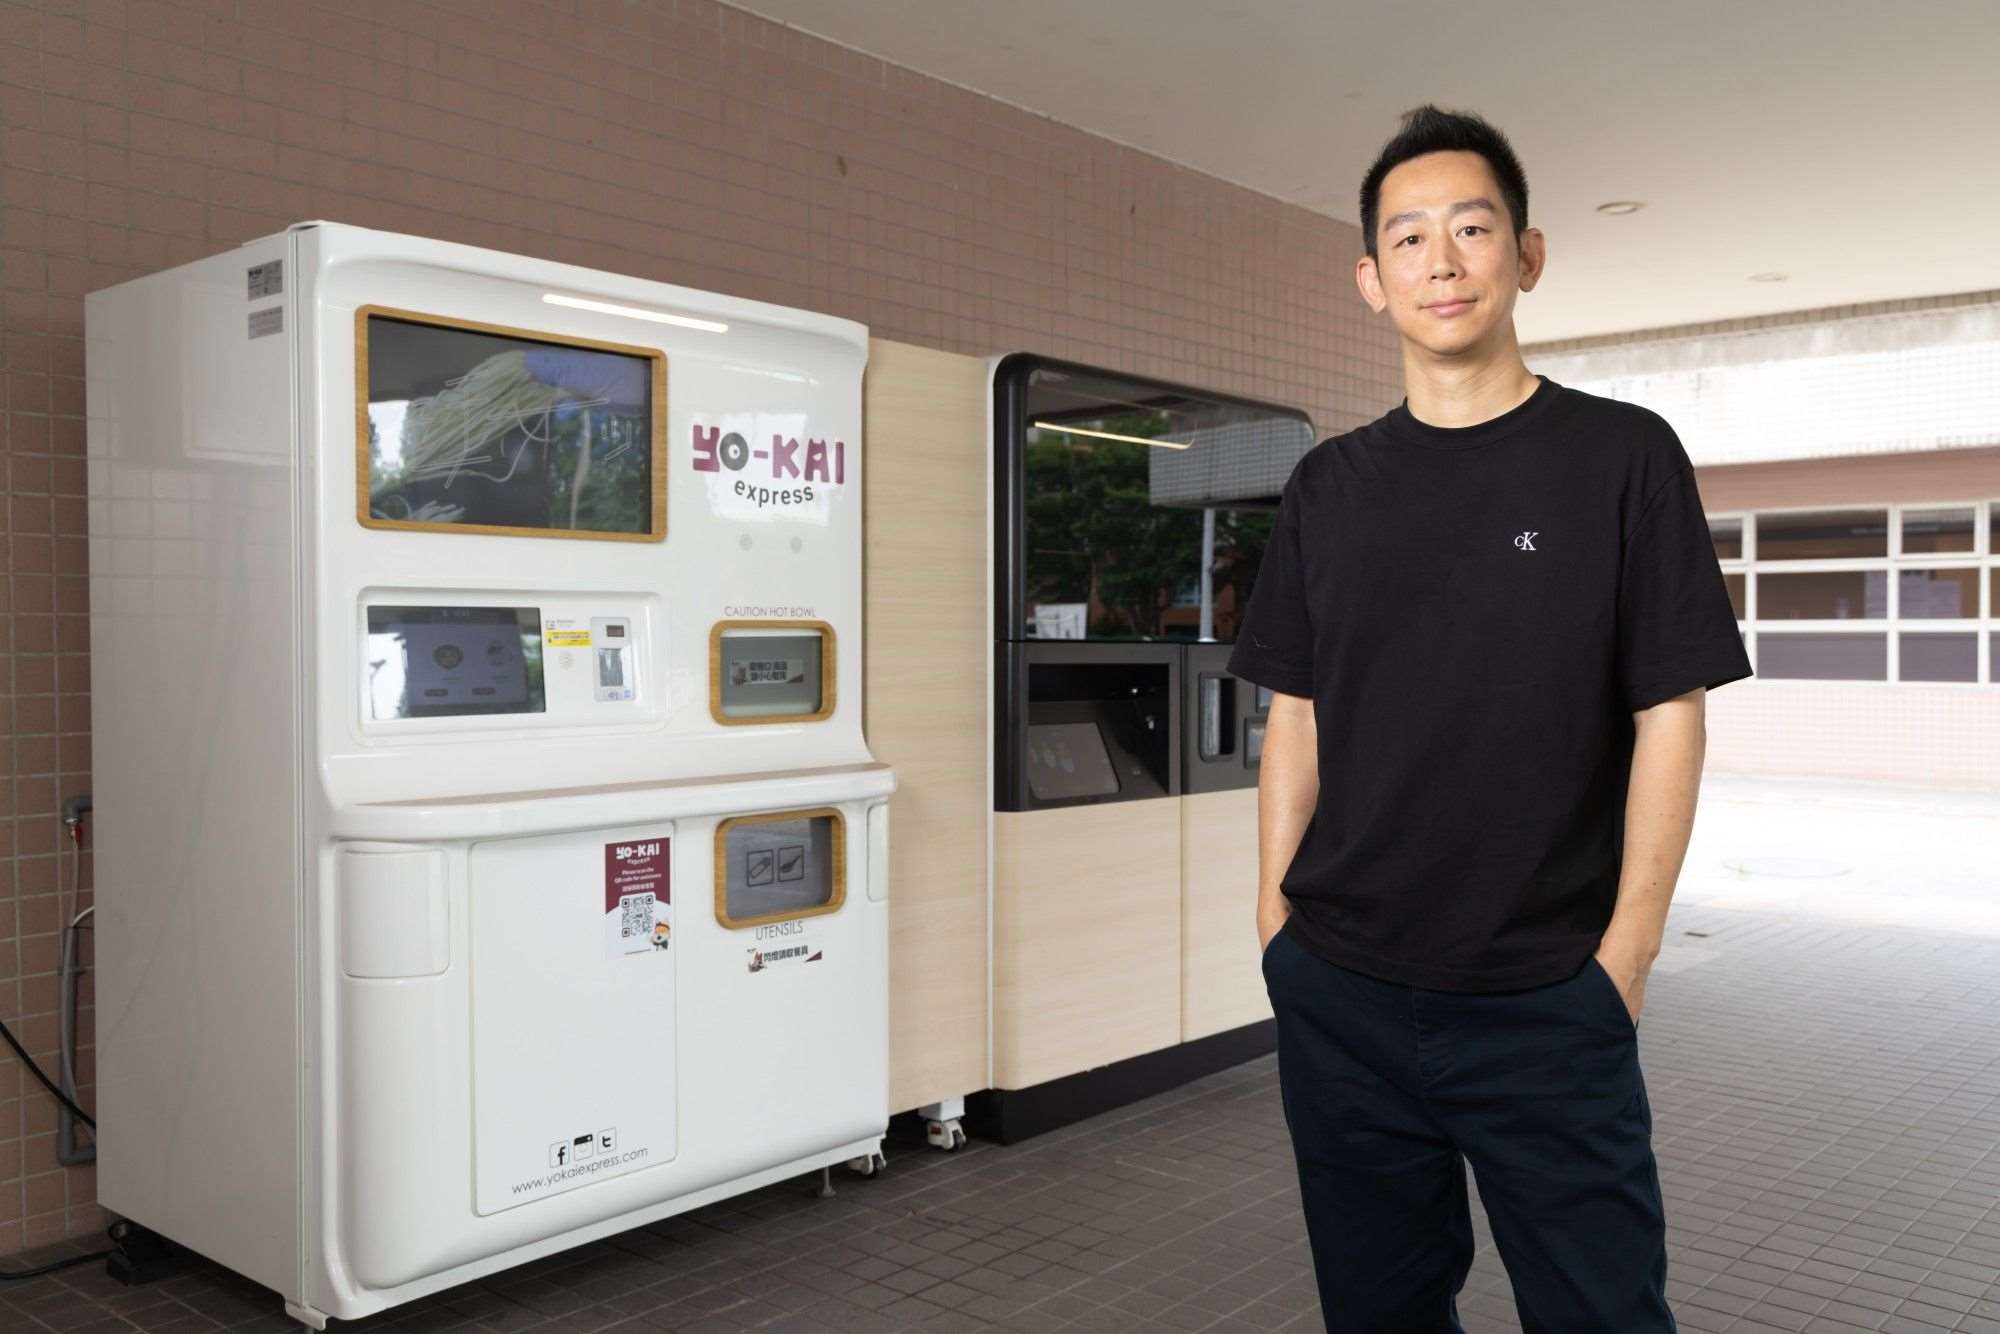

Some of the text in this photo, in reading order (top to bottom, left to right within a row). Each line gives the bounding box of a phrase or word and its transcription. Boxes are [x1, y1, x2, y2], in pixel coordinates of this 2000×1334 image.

[693, 424, 845, 485] YO-KAI
[734, 480, 814, 508] express
[724, 606, 816, 618] CAUTION HOT BOWL
[616, 842, 660, 860] YO-KAI
[627, 857, 651, 865] express
[755, 921, 804, 940] UTENSILS
[511, 1147, 649, 1195] www.yokaiexpress.com
